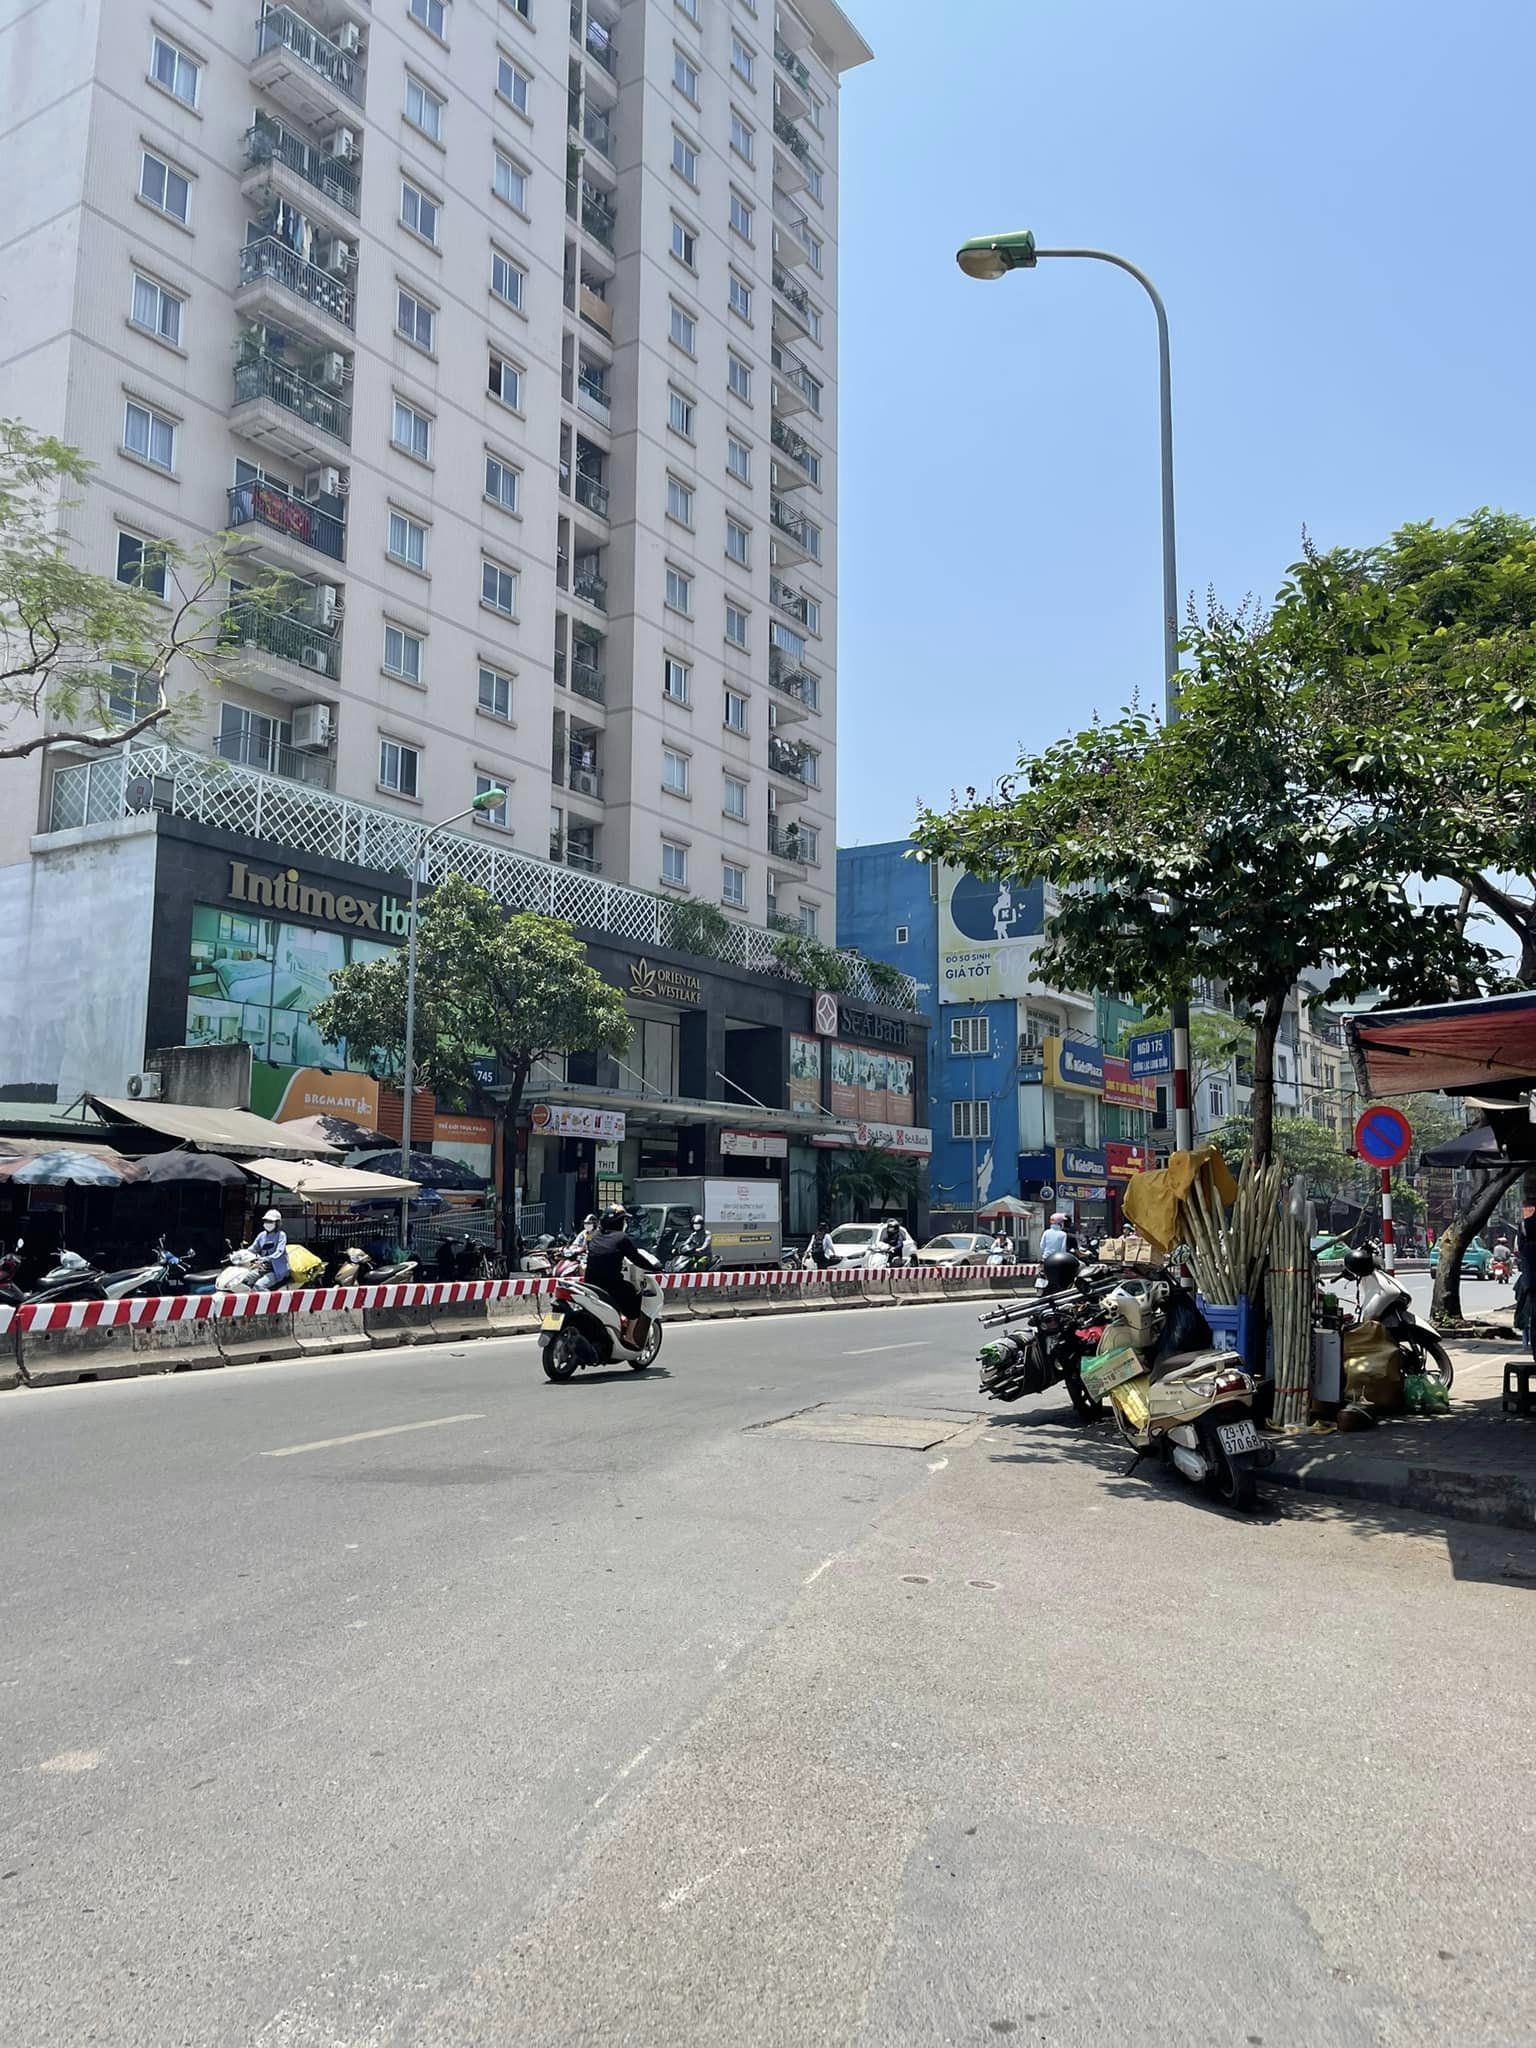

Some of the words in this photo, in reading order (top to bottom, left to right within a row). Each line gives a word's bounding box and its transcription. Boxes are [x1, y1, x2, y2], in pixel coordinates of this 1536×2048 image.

[228, 860, 380, 931] Intimex
[971, 953, 990, 961] SINH
[945, 964, 966, 979] GIÁ
[968, 961, 992, 977] TỐT
[657, 969, 702, 990] ORIENTAL
[657, 983, 701, 1003] WESTLAKE
[841, 1007, 912, 1047] SeABank
[1151, 1039, 1163, 1053] 175
[478, 1070, 493, 1082] 745
[304, 1093, 358, 1108] BRGMART
[904, 1133, 928, 1145] SeABank
[1224, 1423, 1251, 1439] 29-P1
